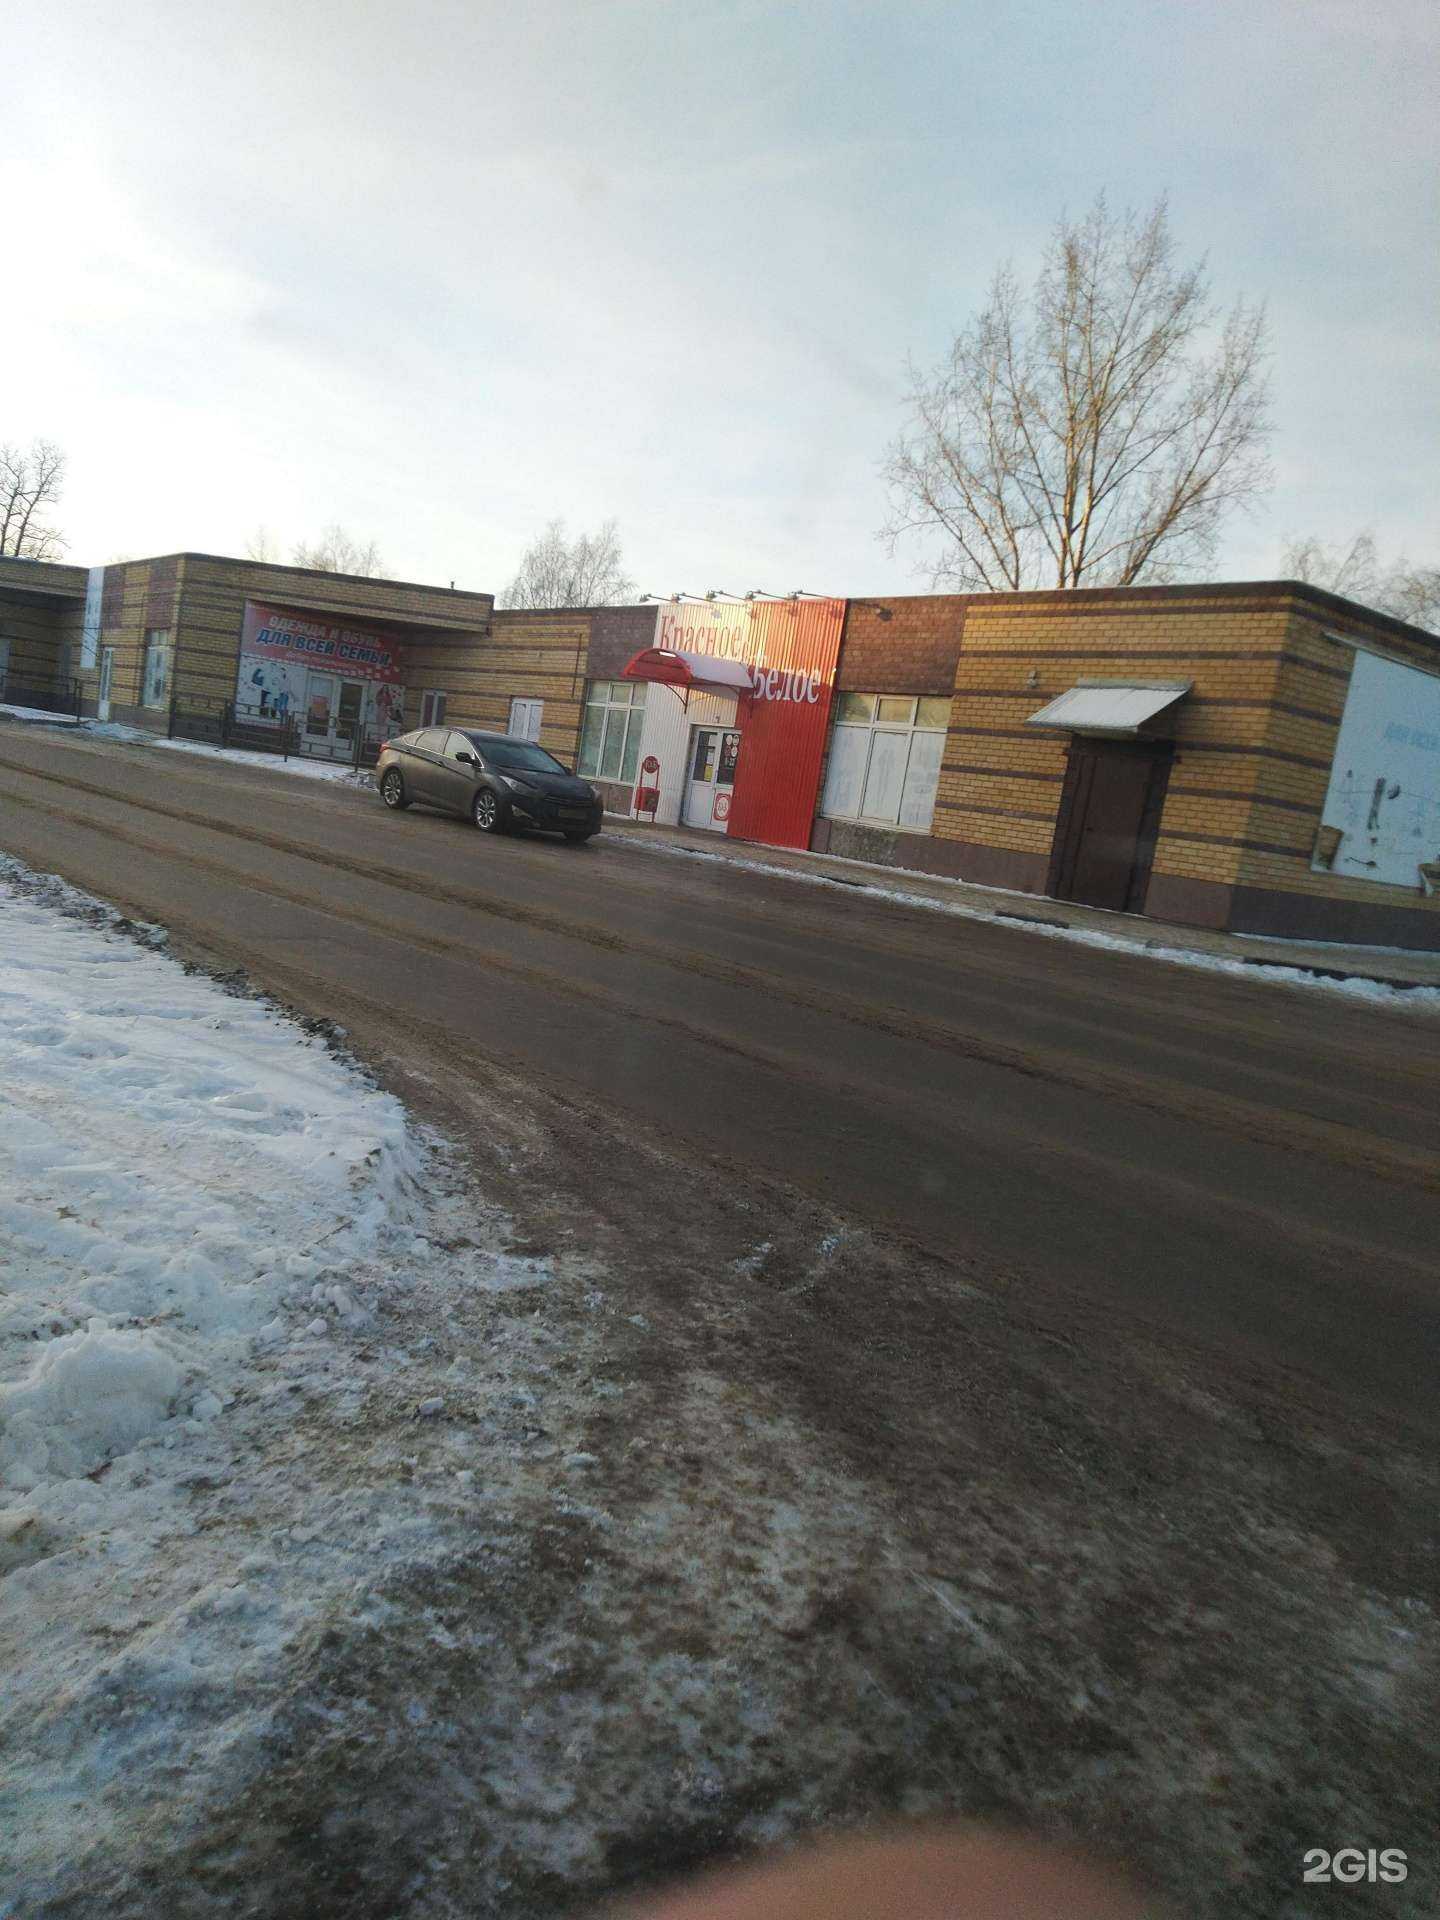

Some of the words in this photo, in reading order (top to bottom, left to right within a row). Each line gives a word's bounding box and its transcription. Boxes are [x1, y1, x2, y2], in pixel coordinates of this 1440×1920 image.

[256, 627, 291, 647] ДЛЯ
[294, 634, 336, 656] ВСЕЙ
[338, 643, 392, 666] СЕМЬИ
